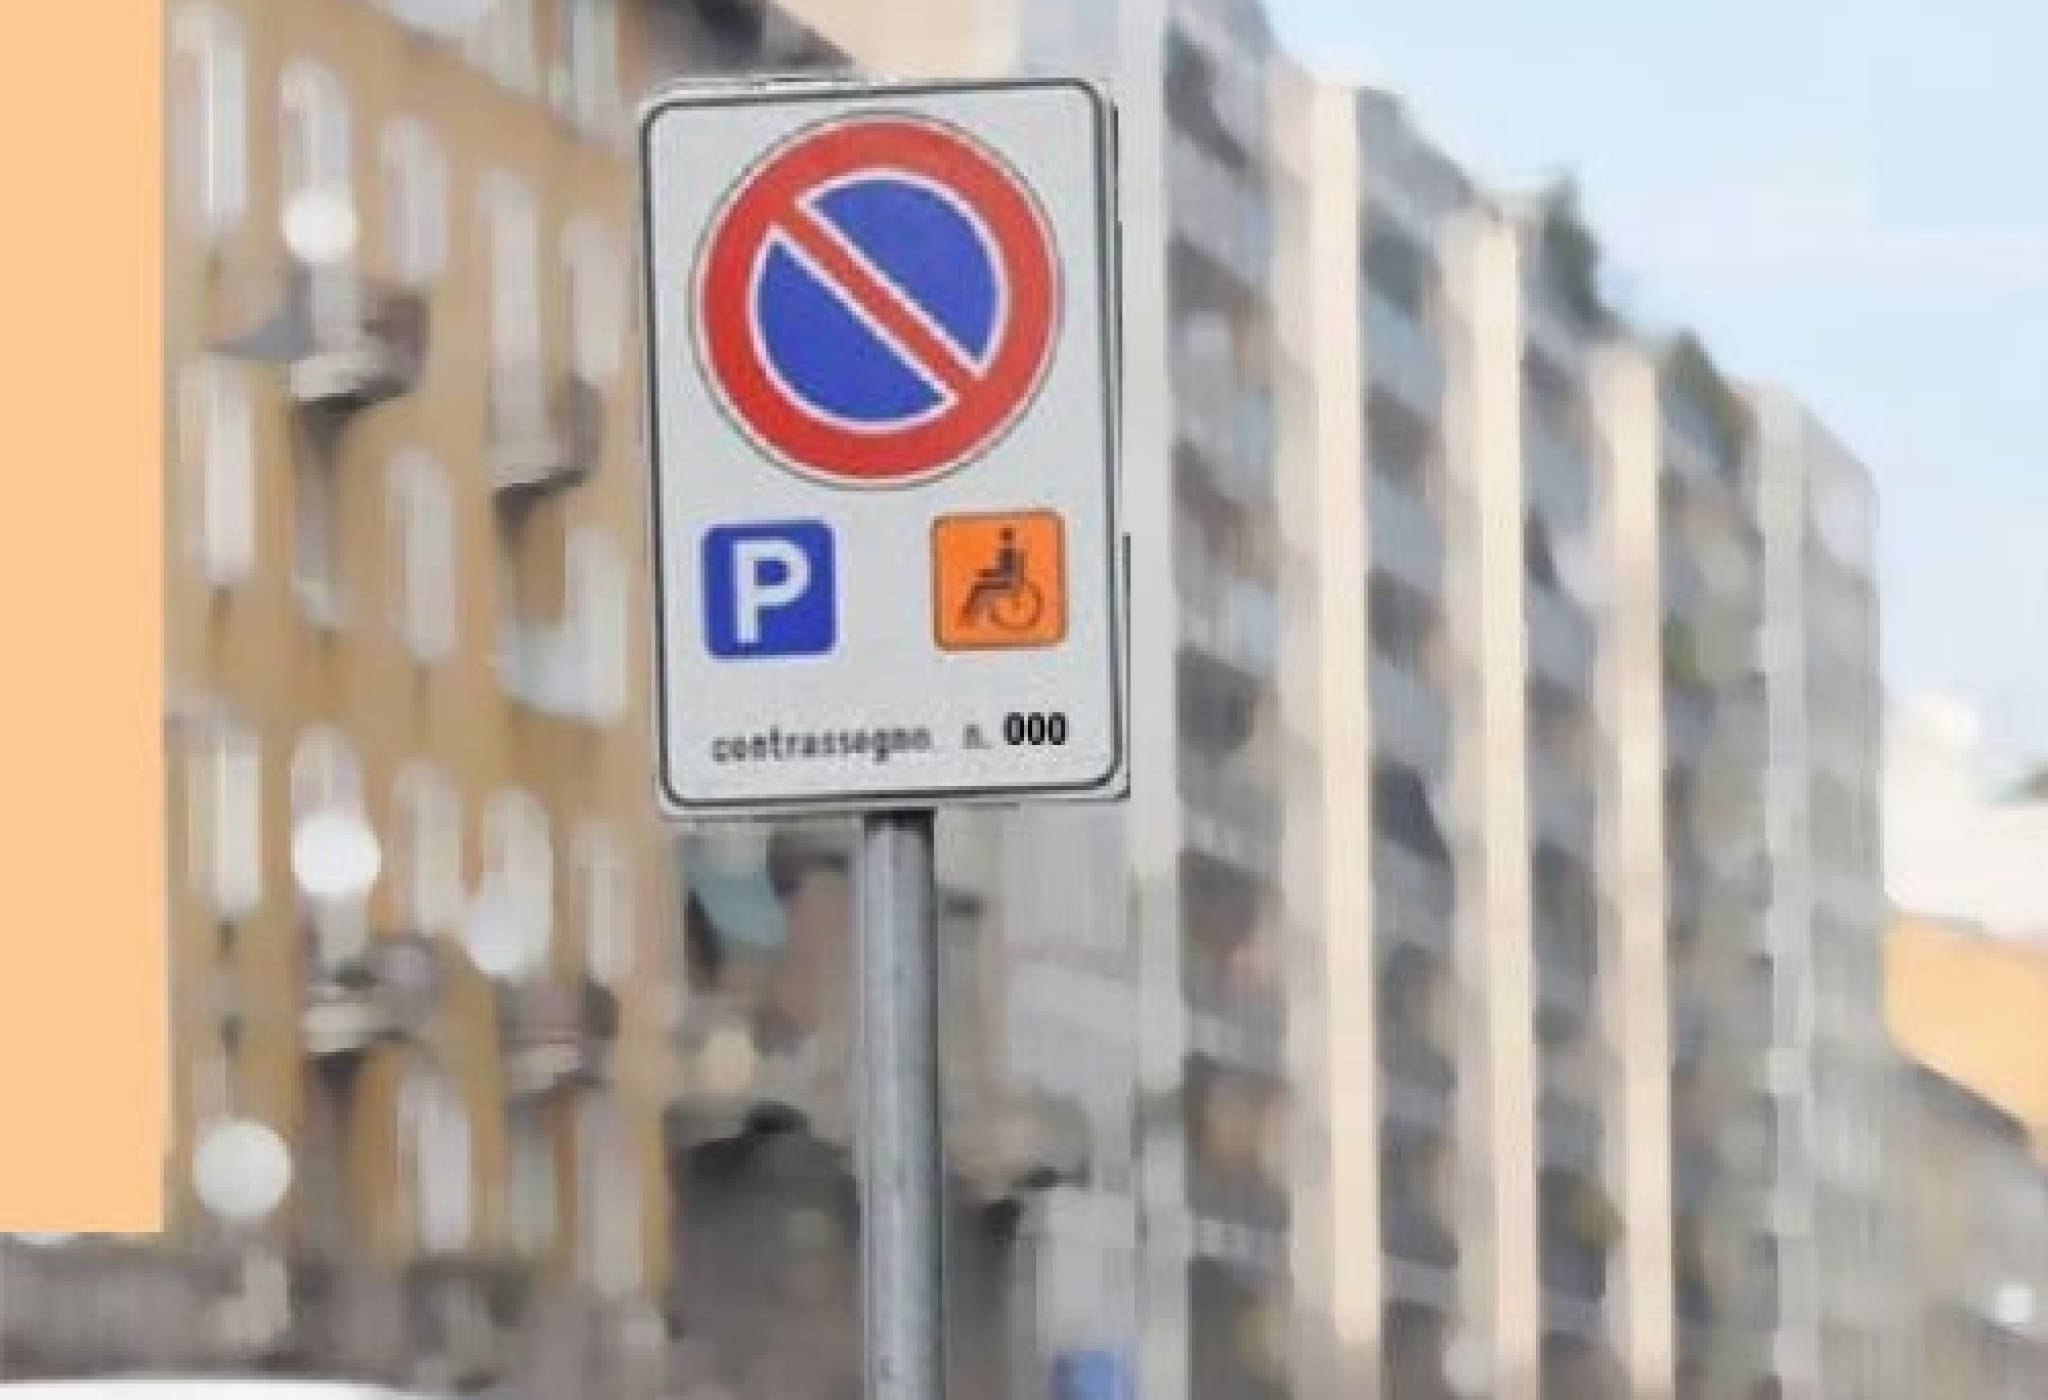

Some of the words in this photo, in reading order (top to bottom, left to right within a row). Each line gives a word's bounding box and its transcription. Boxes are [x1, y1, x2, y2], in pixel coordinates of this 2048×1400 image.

[732, 539, 810, 644] P
[711, 724, 932, 764] contrassegno
[1003, 711, 1067, 746] 000
